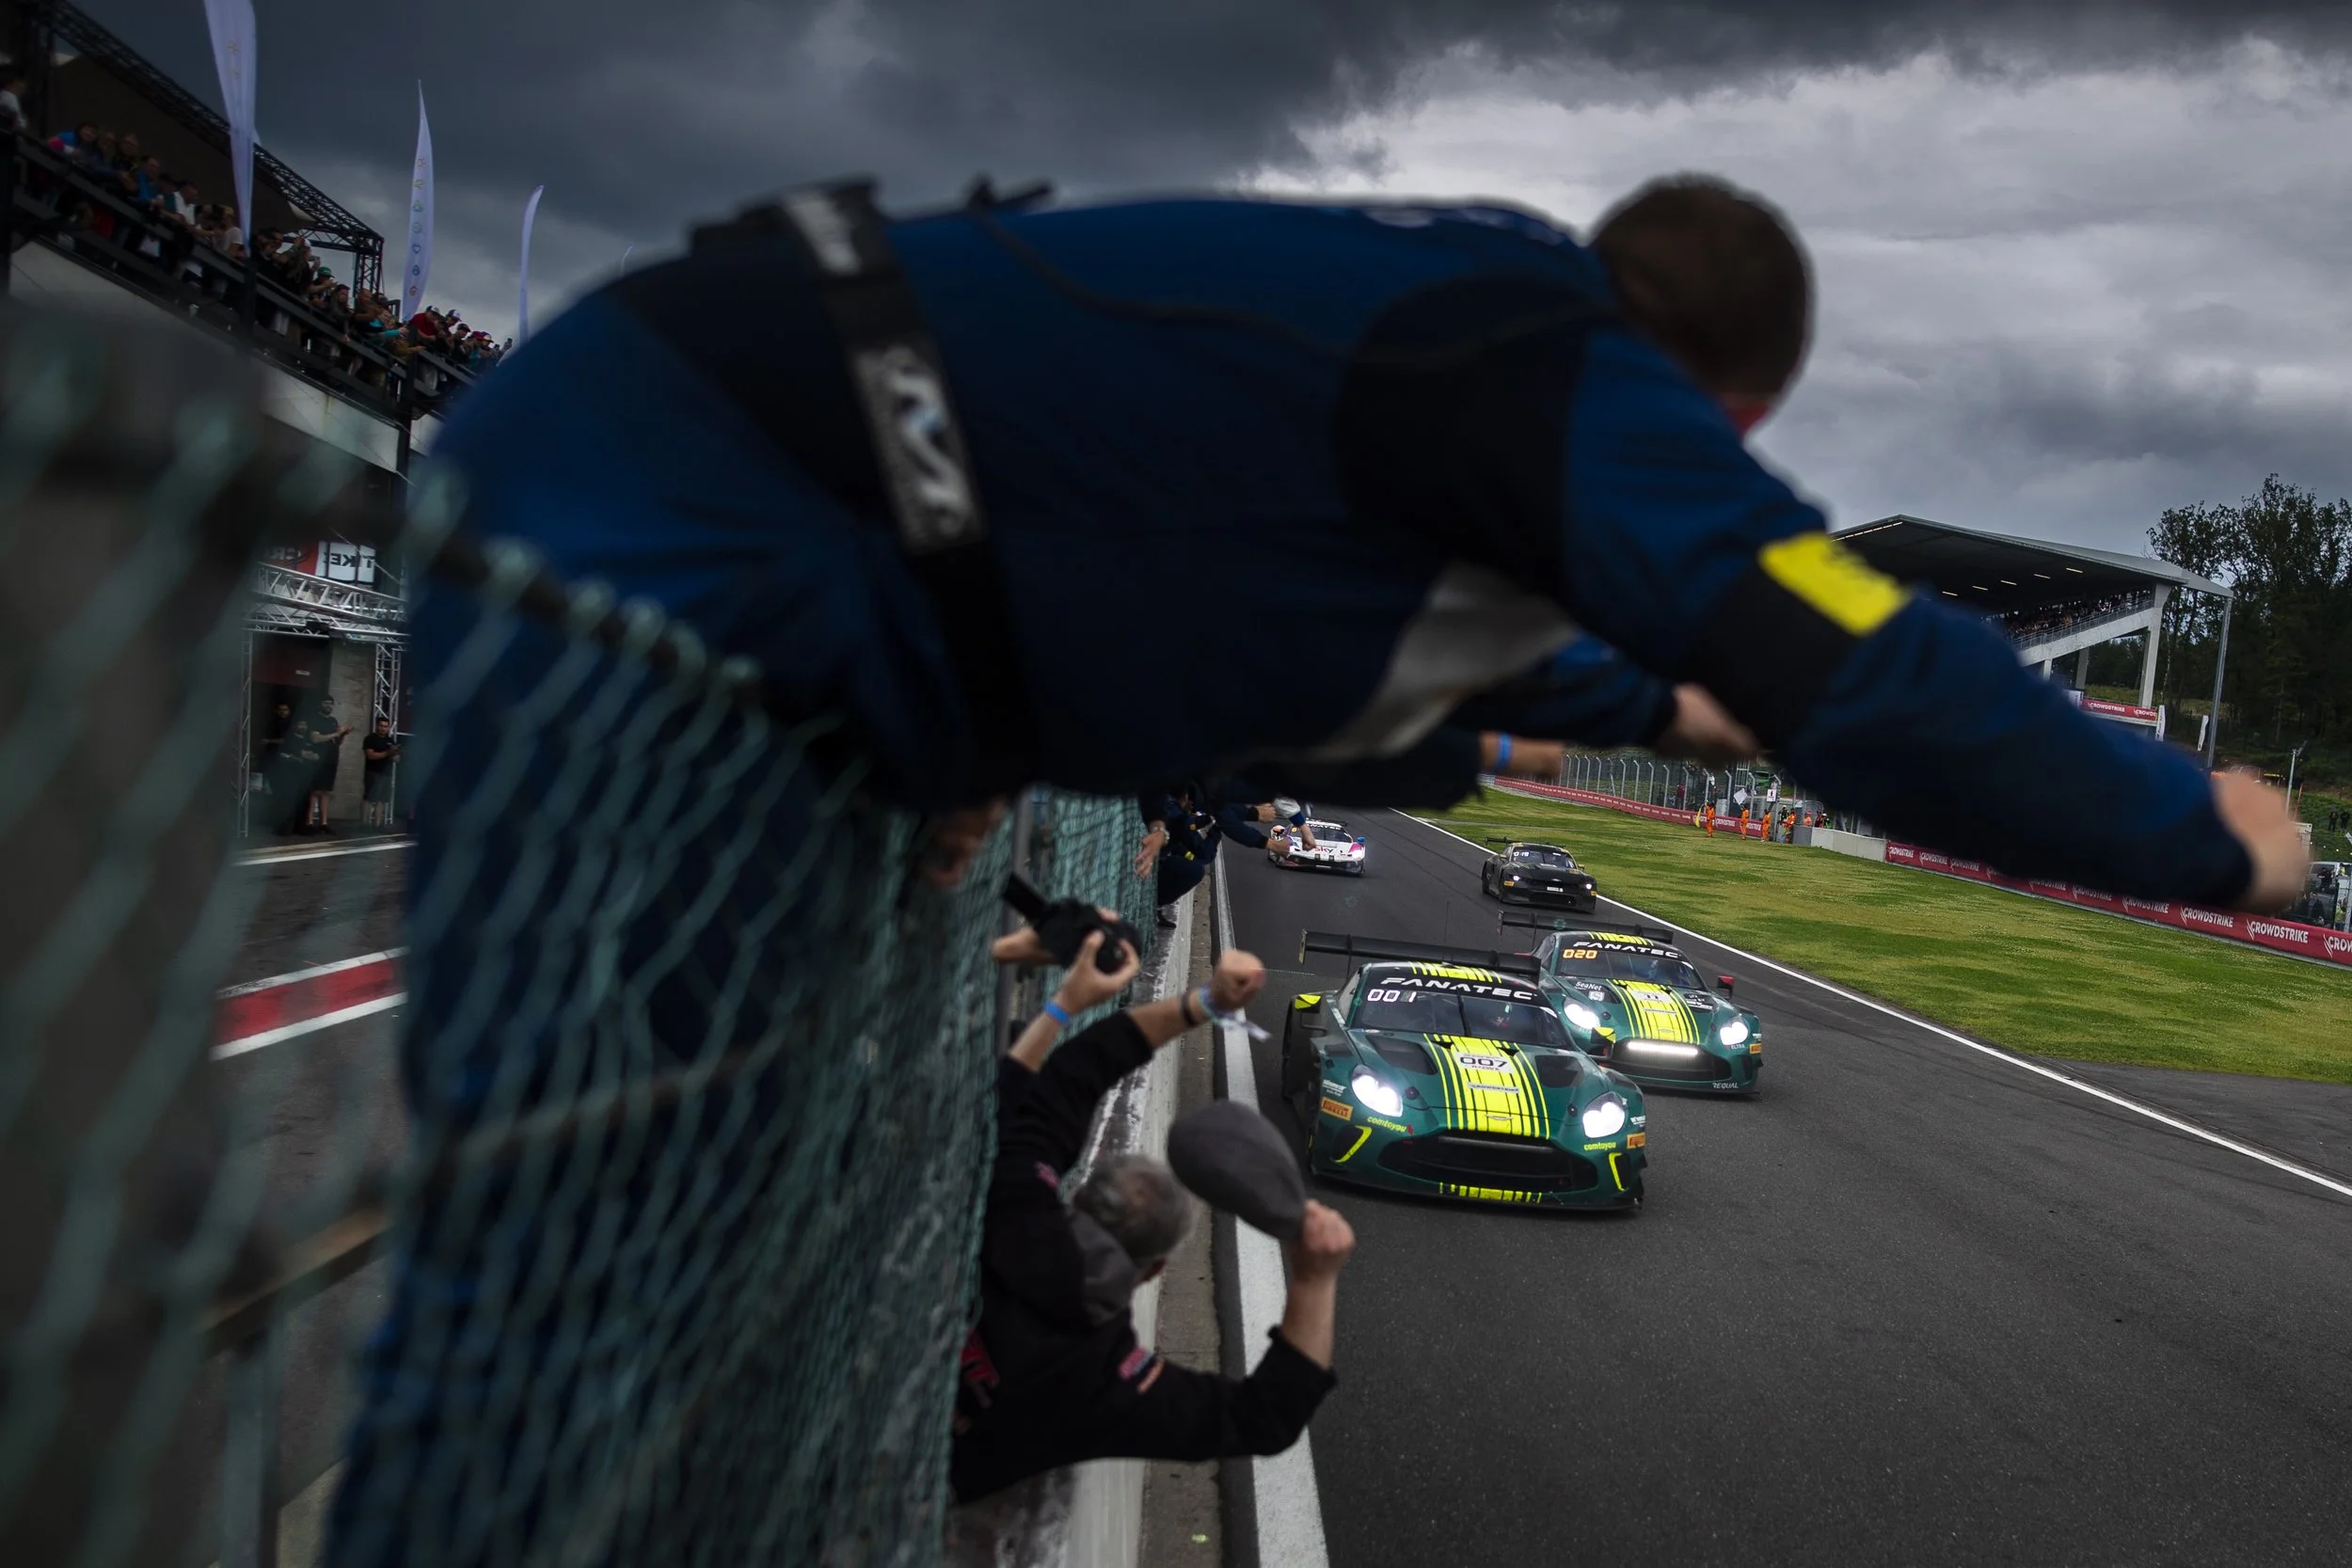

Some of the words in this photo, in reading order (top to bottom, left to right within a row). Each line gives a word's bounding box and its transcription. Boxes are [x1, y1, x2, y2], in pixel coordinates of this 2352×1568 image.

[2090, 702, 2125, 712] CROWDSTRIKE
[2183, 907, 2233, 927] CROWDSTRIKE
[2250, 921, 2309, 943] CROWDSTRIKE
[1563, 948, 1597, 959] 020
[1573, 942, 1678, 958] FANATEC
[1381, 977, 1533, 1001] FANATEC
[1576, 981, 1602, 990] SeaNet
[1460, 1056, 1507, 1068] 007
[1367, 1116, 1407, 1132] comtoyou
[1583, 1142, 1616, 1150] comtoyou
